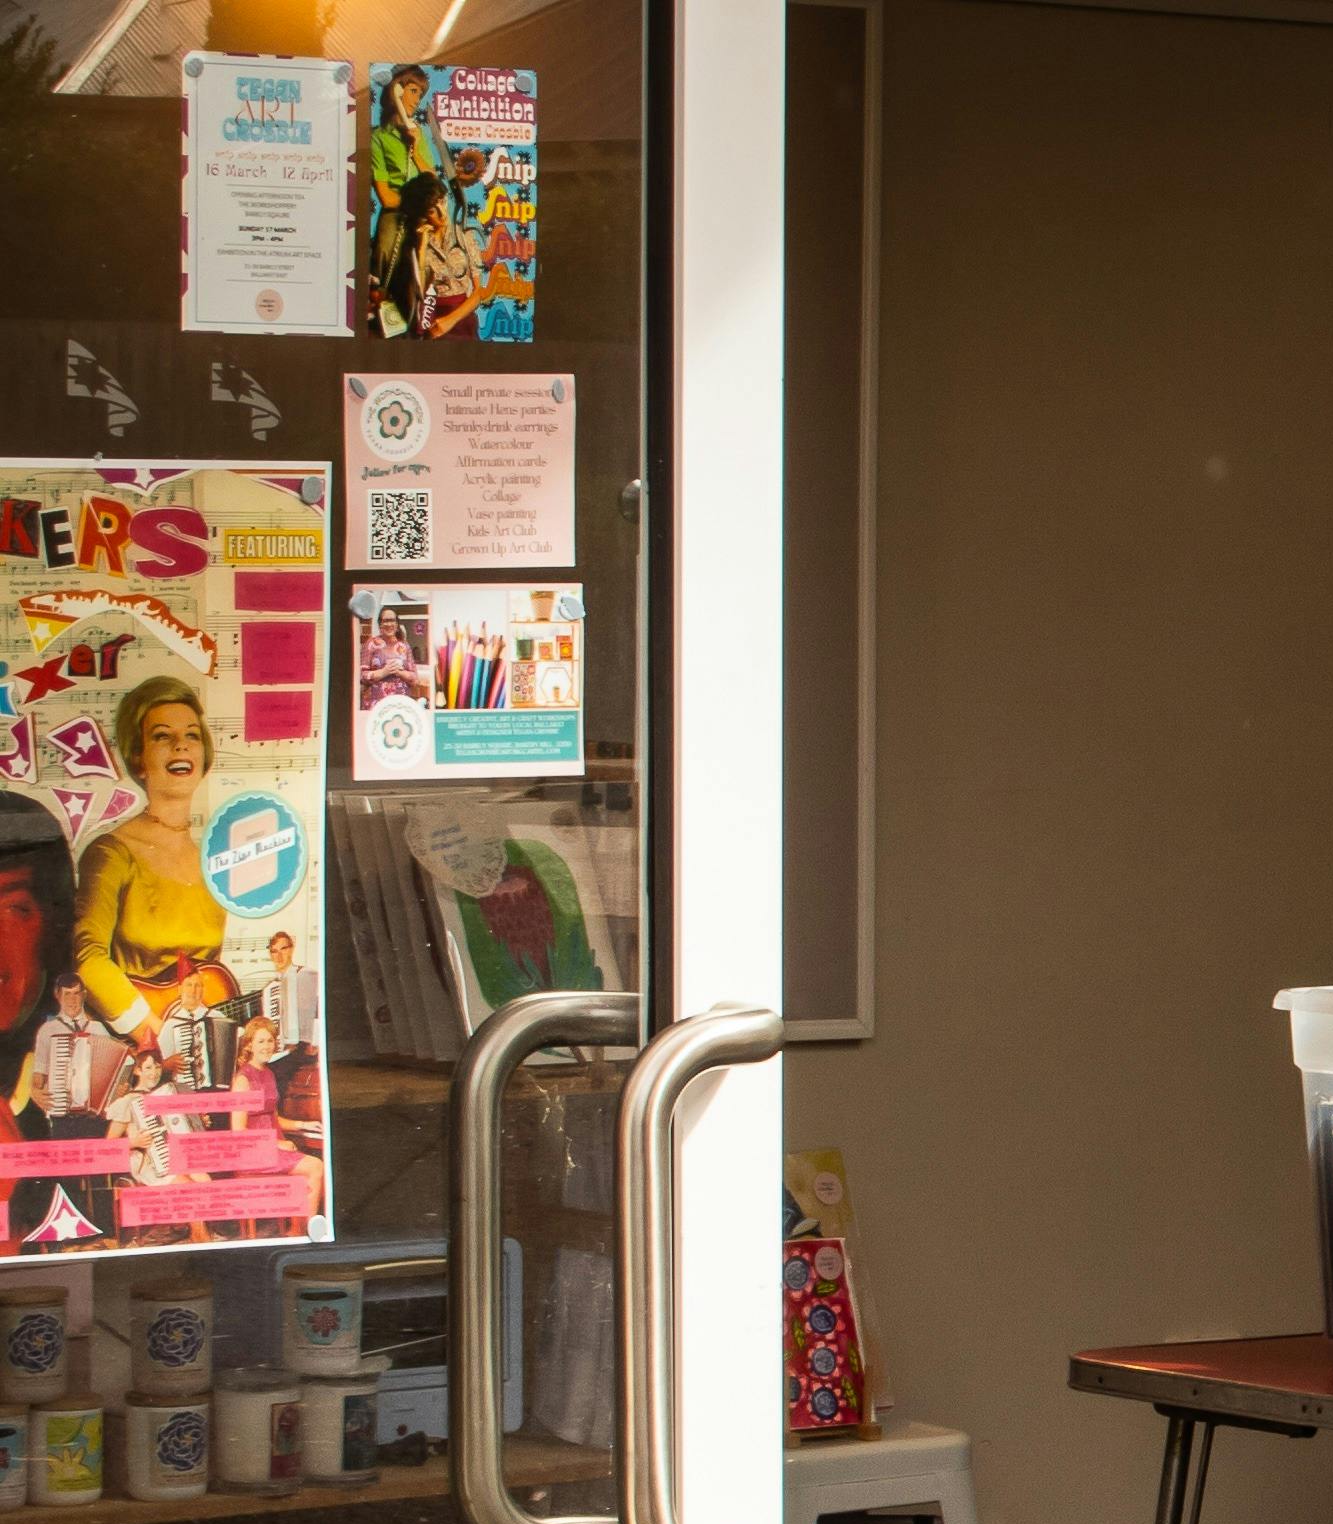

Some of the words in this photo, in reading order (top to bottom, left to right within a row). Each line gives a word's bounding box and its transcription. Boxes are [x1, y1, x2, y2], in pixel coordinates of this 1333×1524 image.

[455, 70, 515, 95] Collage
[437, 95, 535, 121] Exhibition
[206, 163, 220, 176] 16
[226, 164, 267, 178] March
[482, 147, 536, 185] Snip
[283, 166, 296, 180] 12
[301, 167, 334, 184] April
[478, 186, 537, 224] Snip
[442, 385, 473, 398] Small
[476, 387, 511, 400] private
[446, 403, 487, 415] Intimate
[521, 405, 556, 418] parties
[514, 423, 559, 436] earrings
[468, 438, 534, 450] Watercolour
[456, 456, 515, 468] Affirmation
[518, 456, 547, 468] cards
[462, 472, 497, 489] Acrylic
[501, 473, 542, 488] painting
[482, 489, 522, 505] Collage
[467, 507, 494, 519] Vase
[497, 509, 537, 522] painting
[467, 524, 490, 537] Kids
[493, 525, 510, 536] Art
[512, 524, 537, 537] Club
[451, 543, 488, 555] Grown
[491, 543, 507, 557] Up
[510, 543, 526, 554] Art
[529, 541, 553, 553] Club
